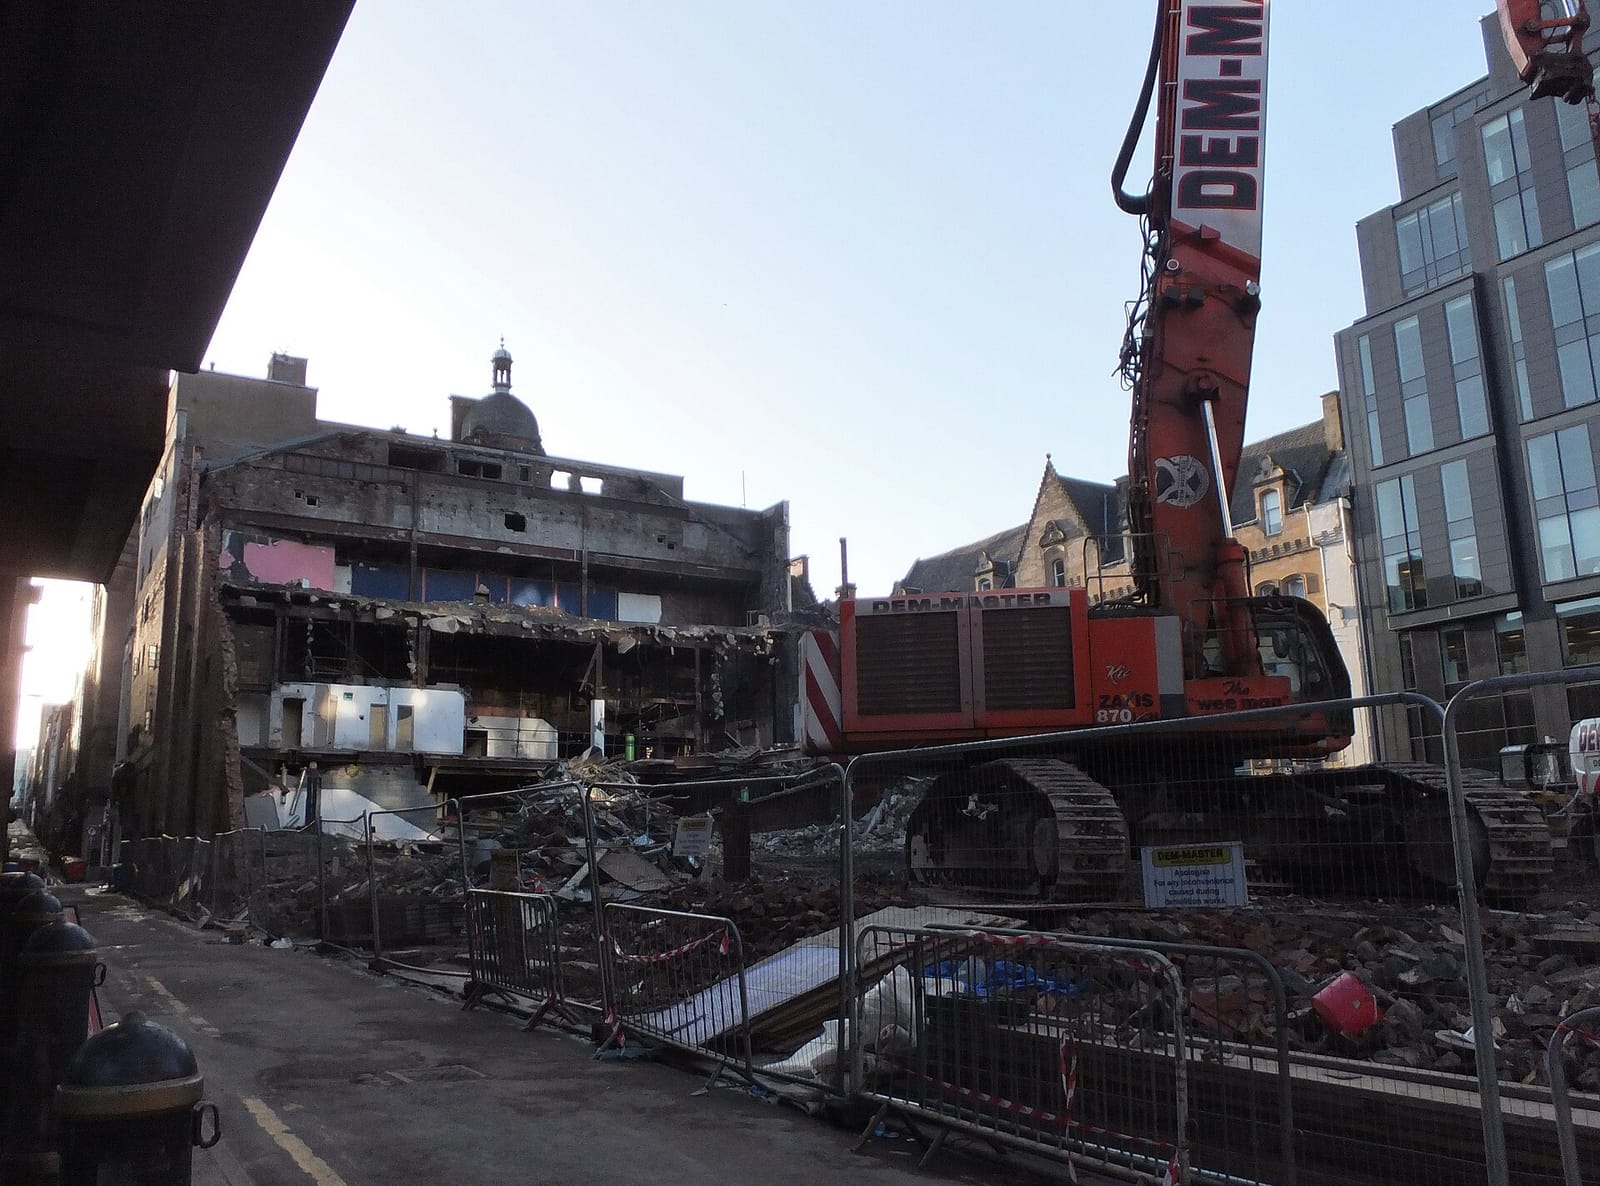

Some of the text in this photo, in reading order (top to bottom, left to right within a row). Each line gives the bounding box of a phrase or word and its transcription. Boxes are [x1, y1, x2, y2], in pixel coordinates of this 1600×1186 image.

[1177, 0, 1264, 210] DEM-M
[872, 593, 1051, 613] DEM-MASTER
[1097, 709, 1132, 722] 870
